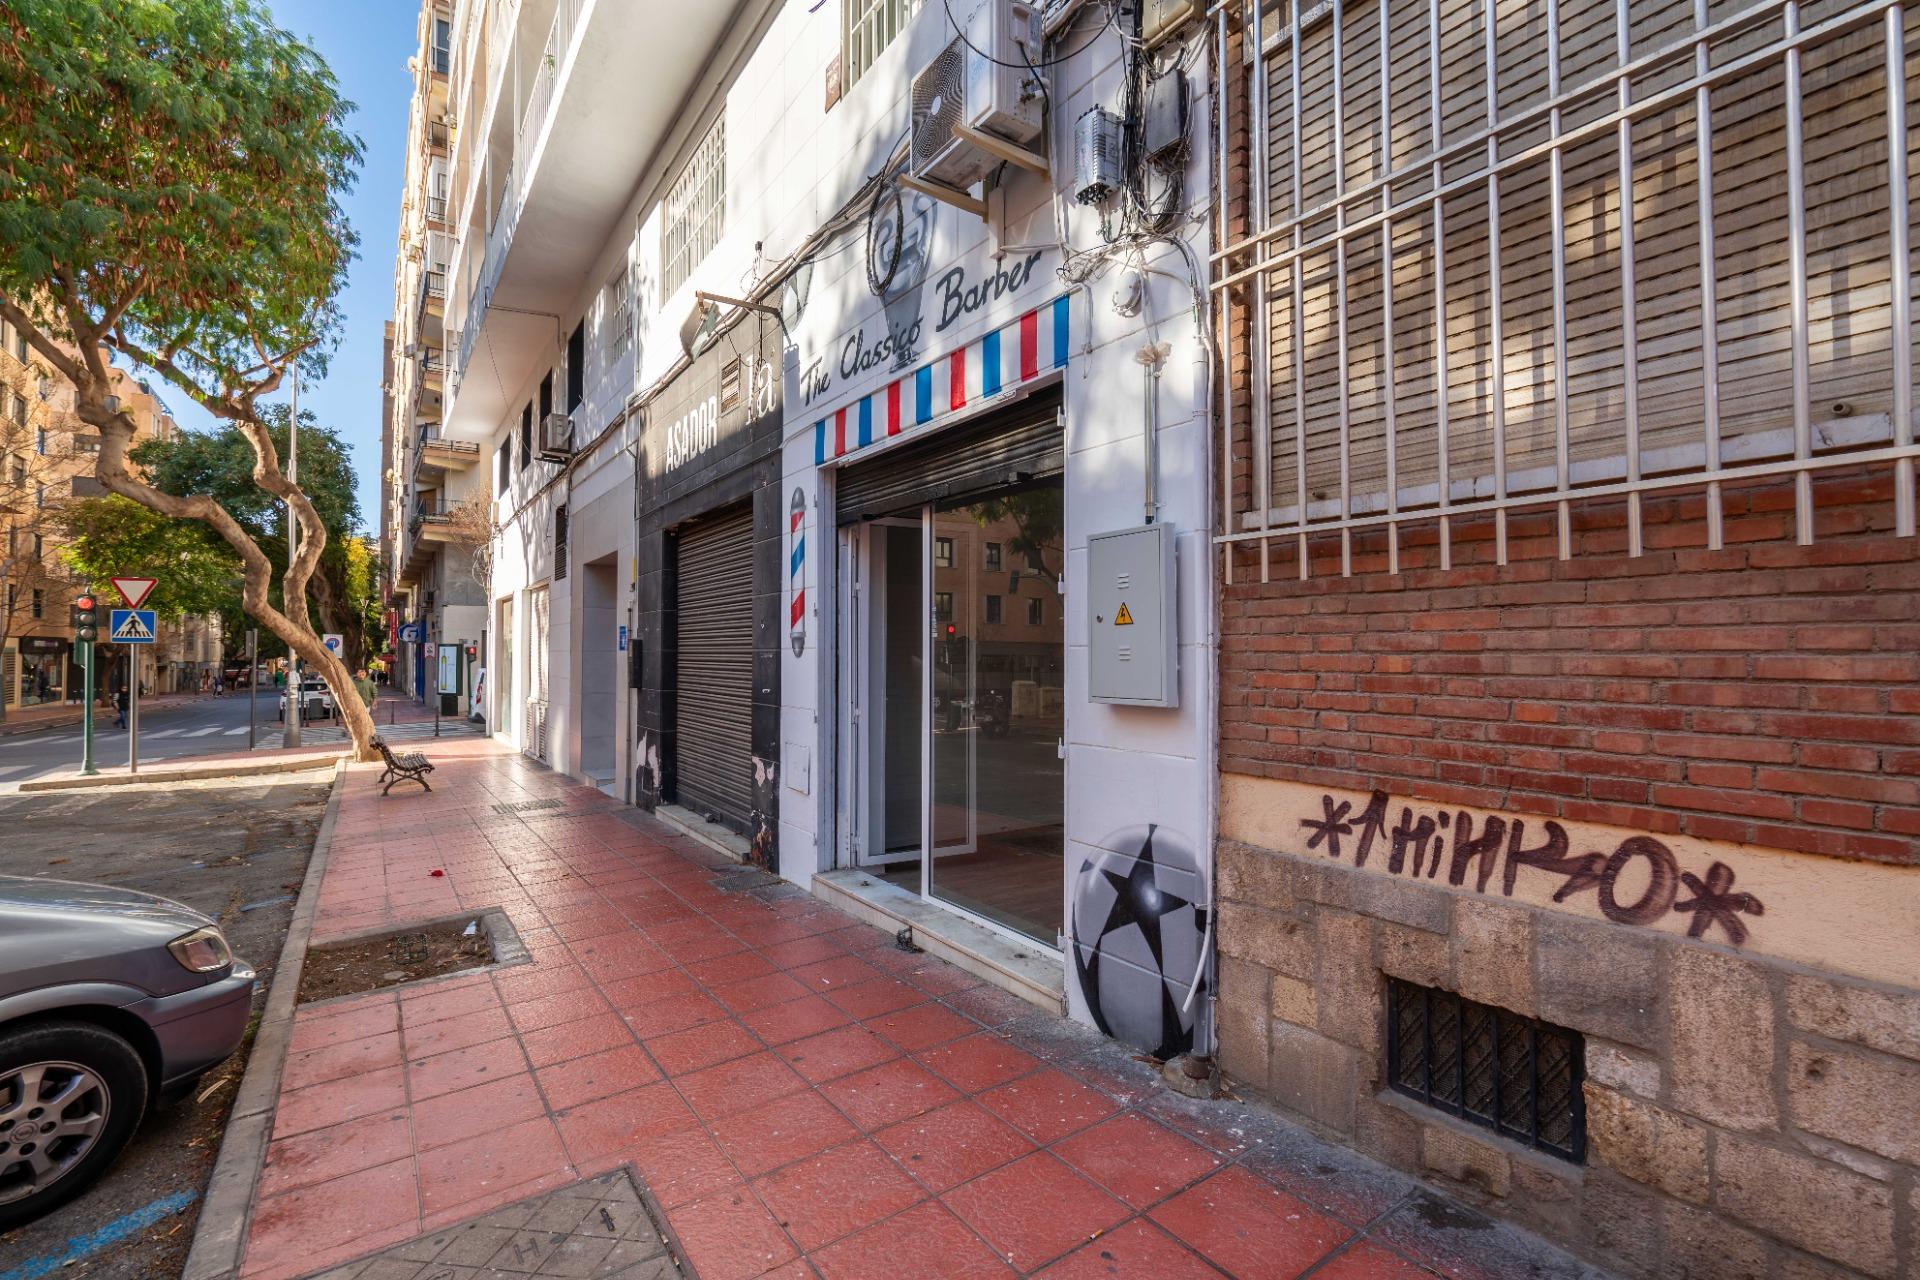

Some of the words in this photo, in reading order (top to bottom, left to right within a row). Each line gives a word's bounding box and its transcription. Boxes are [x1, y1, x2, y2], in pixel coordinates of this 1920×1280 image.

[800, 356, 831, 407] The
[840, 315, 925, 381] Classico
[935, 250, 1042, 333] Barber
[665, 395, 718, 475] ASADOR
